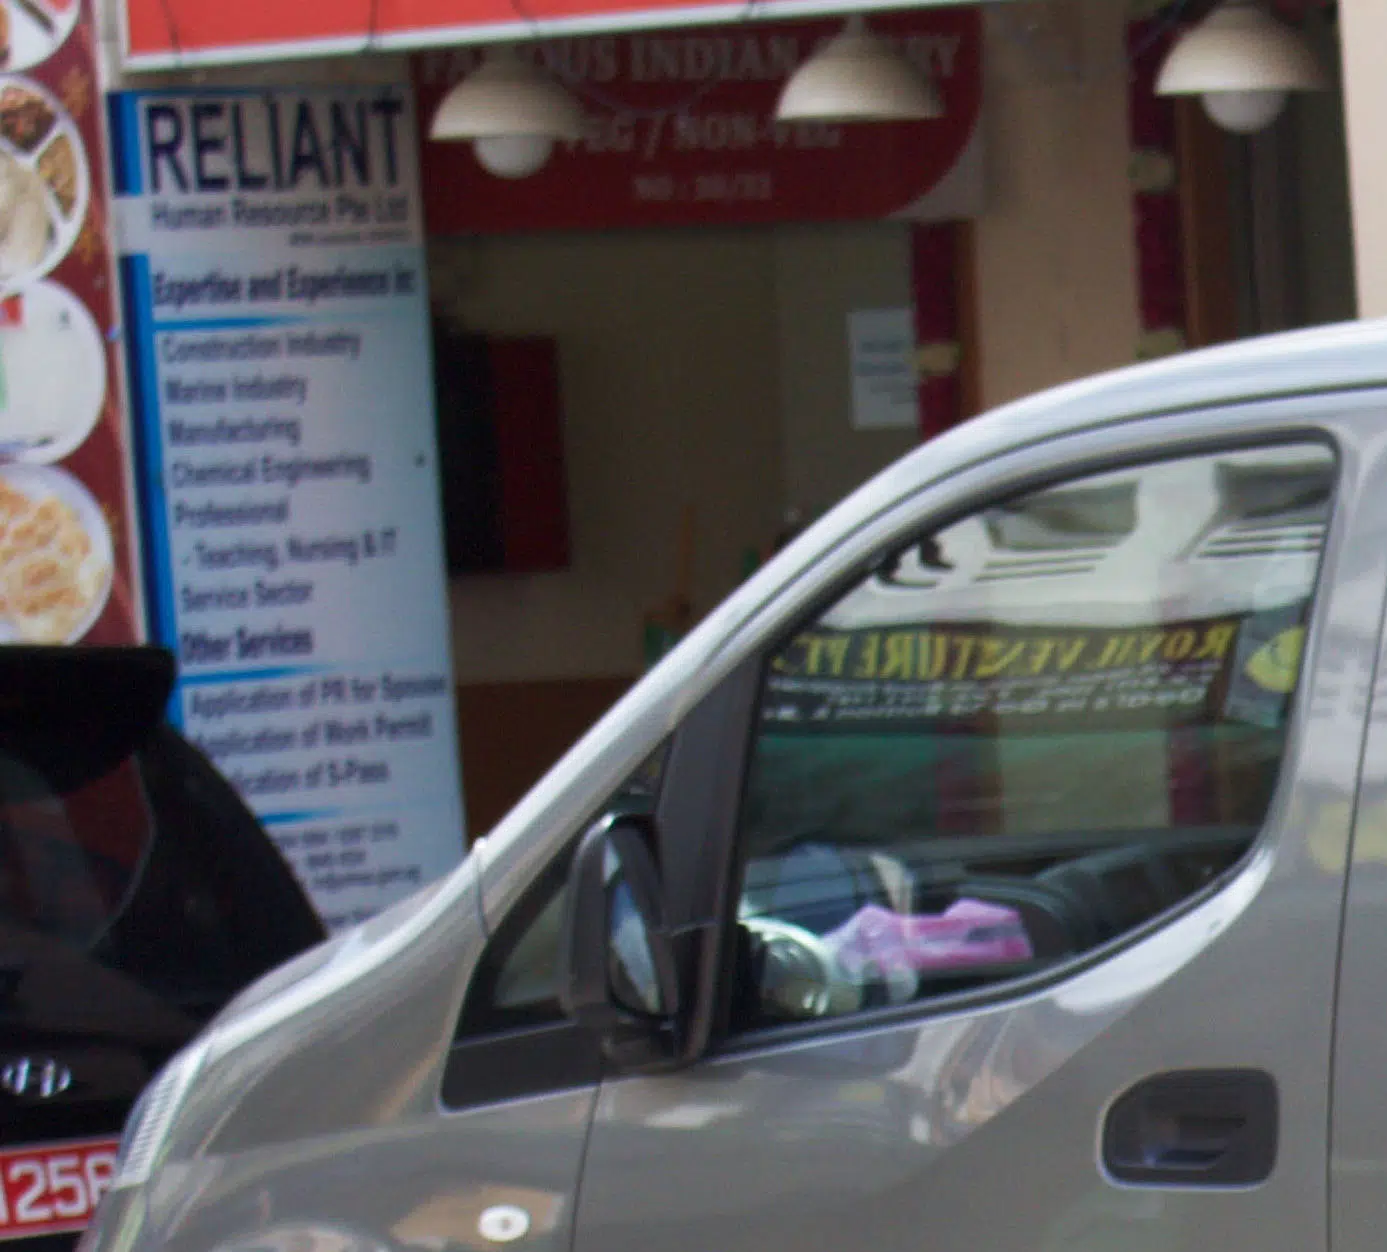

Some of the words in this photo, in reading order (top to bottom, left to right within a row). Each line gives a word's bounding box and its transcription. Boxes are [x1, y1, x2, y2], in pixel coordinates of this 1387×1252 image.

[145, 96, 404, 193] RELIANT
[152, 203, 228, 232] Human
[248, 269, 281, 300] and
[161, 333, 281, 364] Construction
[168, 416, 302, 448] Manufacturing
[172, 458, 256, 489] Chemical
[262, 454, 371, 488] Engineering
[182, 585, 249, 613] Service
[181, 632, 233, 664] Other
[236, 625, 314, 660] Services
[191, 684, 296, 721] Application
